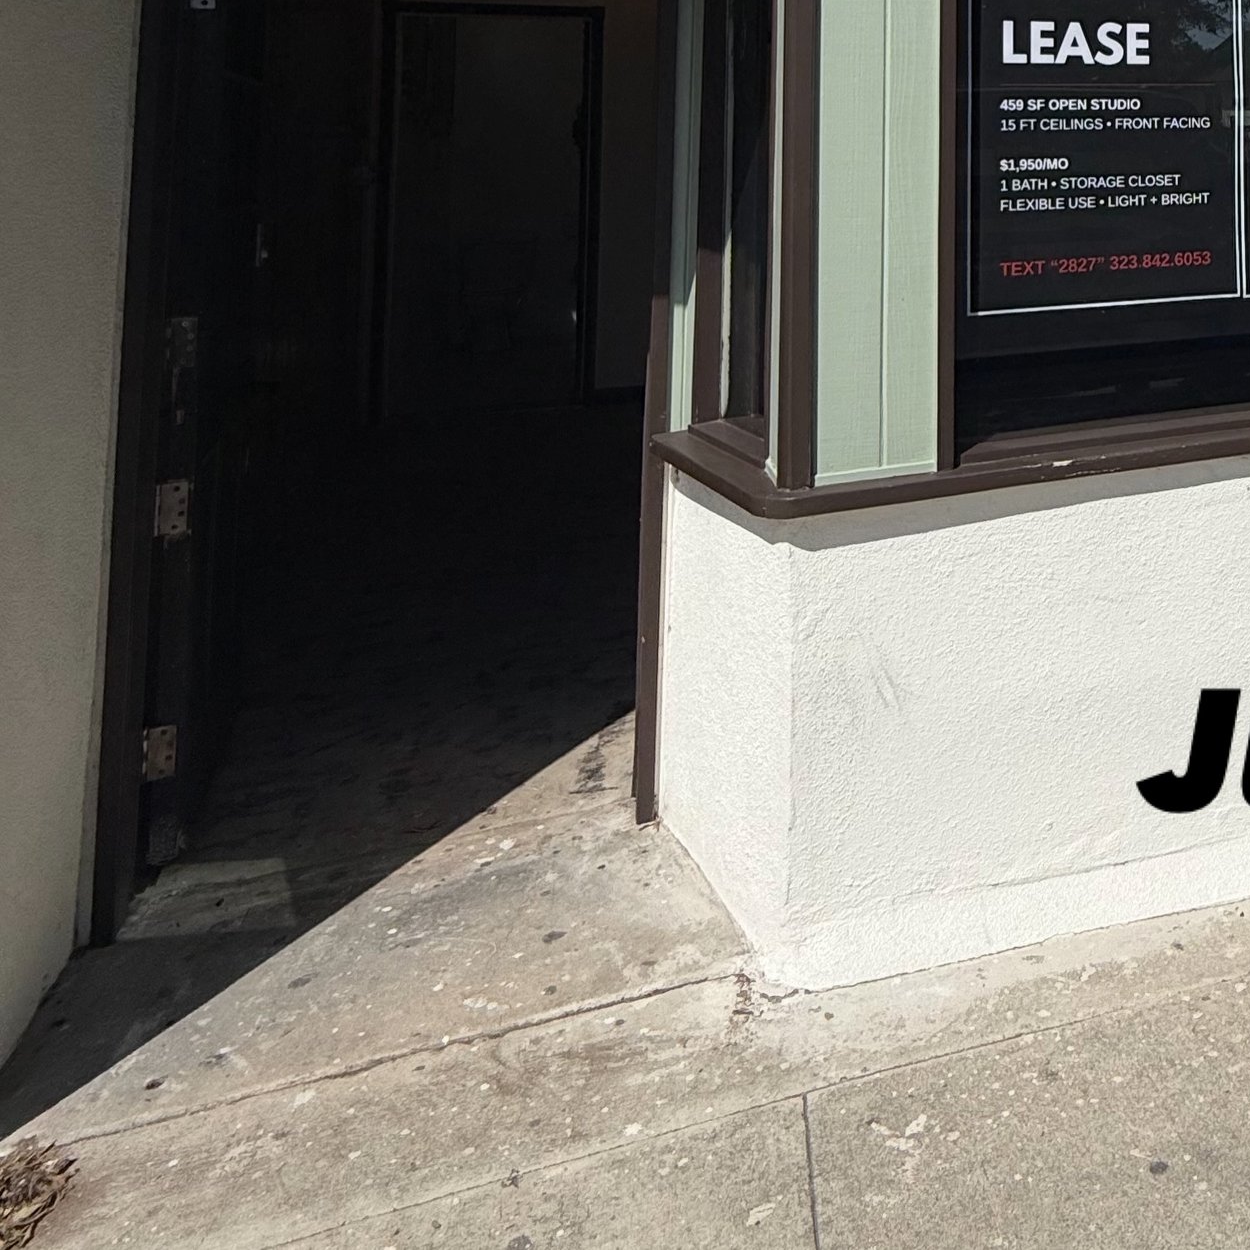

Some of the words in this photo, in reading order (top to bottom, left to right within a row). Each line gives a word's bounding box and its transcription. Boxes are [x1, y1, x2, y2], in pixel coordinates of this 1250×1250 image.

[1002, 20, 1150, 65] LEASE
[1000, 99, 1023, 111] 459
[1027, 99, 1045, 111] SF
[1049, 99, 1087, 111] OPEN
[1090, 98, 1141, 111] STUDIO
[1000, 119, 1016, 131] 15
[1020, 119, 1036, 131] FT
[1040, 118, 1103, 130] CEILINGS
[1115, 118, 1159, 129] FRONT
[1163, 117, 1210, 129] FACING
[1000, 158, 1069, 172] $1,950/MO
[1000, 180, 1008, 191] 1
[1012, 179, 1048, 191] BATH
[1060, 176, 1125, 189] STORAGE
[1128, 174, 1181, 187] CLOSET
[1000, 197, 1065, 211] FLEXIBLE
[1068, 197, 1096, 209] USE
[1108, 195, 1146, 207] LIGHT
[1161, 192, 1210, 206] BRIGHT
[1000, 260, 1045, 276] TEXT
[1109, 251, 1211, 270] 323.842.6053
